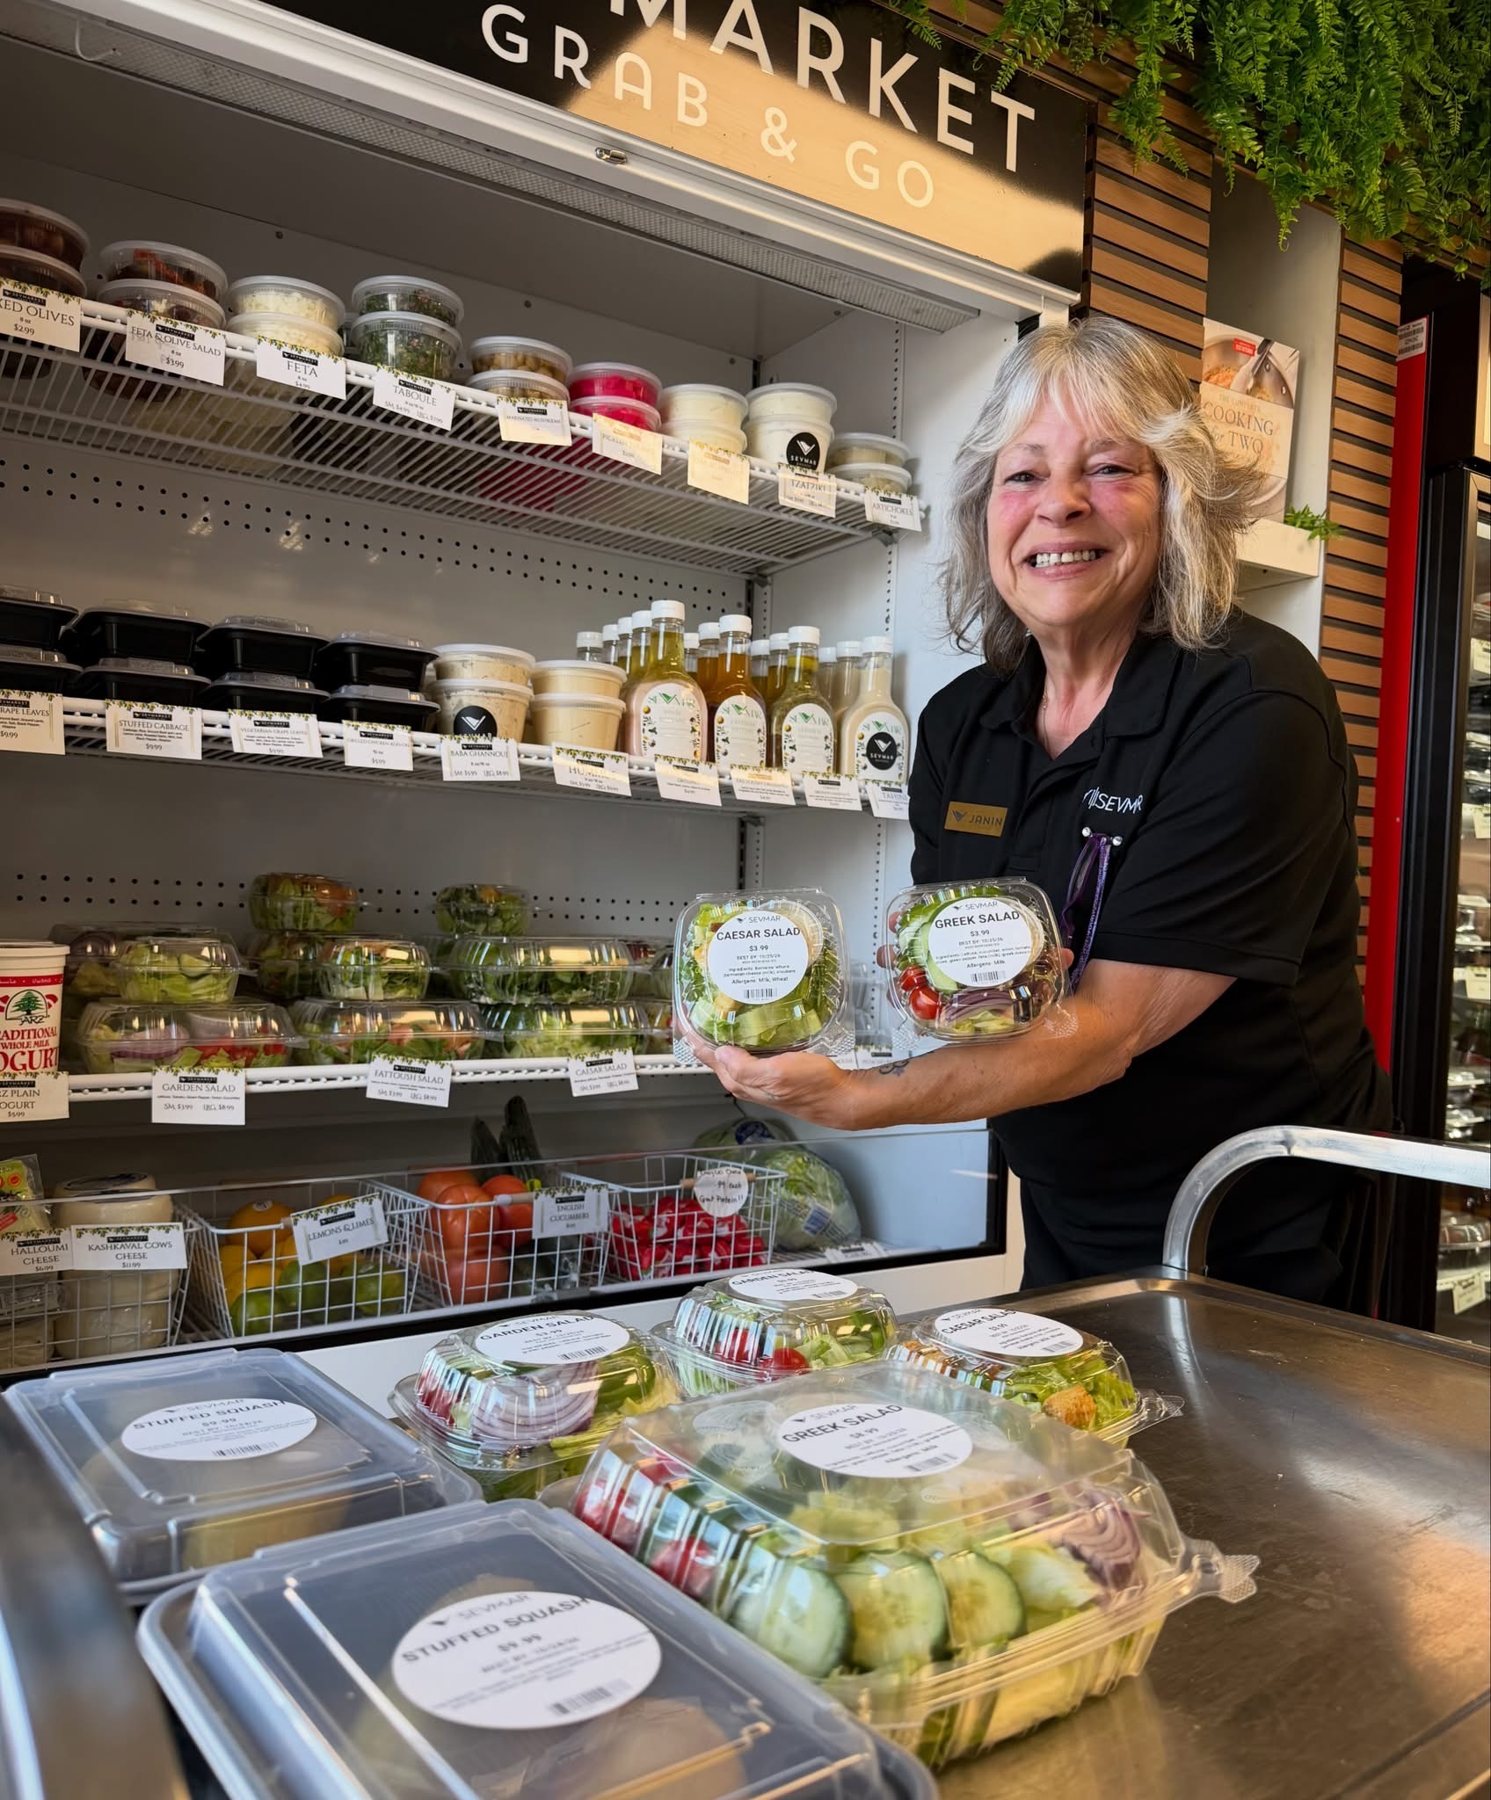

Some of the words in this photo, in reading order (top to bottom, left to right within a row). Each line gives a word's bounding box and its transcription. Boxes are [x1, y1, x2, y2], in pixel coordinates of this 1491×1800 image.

[481, 4, 709, 127] GRAB
[760, 106, 797, 161] &
[845, 140, 934, 208] GO
[26, 305, 75, 327] OLIVES
[131, 326, 153, 339] FETA
[163, 335, 191, 350] OLIVE
[192, 343, 221, 358] SALAD
[287, 361, 318, 378] FETA
[393, 385, 438, 407] TABOULE
[1203, 401, 1273, 436] COOKING
[1229, 430, 1263, 454] TWO
[0, 707, 21, 716] RAPE
[22, 709, 50, 717] LEAVES
[119, 720, 152, 729] STUFFED
[154, 723, 189, 731] CABBAGE
[965, 901, 998, 911] SEVMAR
[749, 915, 781, 924] SEVMAR
[935, 915, 976, 929] GREEK
[978, 910, 1020, 924] SALAD
[716, 930, 761, 941] CAESAR
[763, 927, 801, 938] SALAD
[749, 944, 769, 952] $3.99
[0, 1026, 57, 1041] ADITIONAL
[1, 1041, 33, 1050] WHOLE
[0, 1047, 59, 1073] OGURT
[604, 1063, 628, 1073] SALAD
[374, 1070, 416, 1081] FATTOUSH
[417, 1074, 444, 1085] SALAD
[162, 1083, 203, 1093] GARDEN
[205, 1084, 236, 1093] SALAD
[0, 1101, 35, 1109] OGURT
[557, 1203, 585, 1213] ENGLISH
[308, 1225, 343, 1241] LEMONS
[352, 1217, 375, 1231] LIMES
[11, 1243, 69, 1255] HALLOUMI
[88, 1242, 144, 1252] KASHKAVAL
[144, 1241, 173, 1250] COWS
[23, 1255, 60, 1265] CHEESE
[115, 1252, 148, 1261] CHEESE
[480, 1324, 543, 1341] GARDEN
[546, 1316, 595, 1329] SALAD
[941, 1318, 981, 1334] CAESAR
[981, 1309, 1017, 1323] SALAD
[133, 1412, 211, 1430] STUFFED
[216, 1400, 286, 1416] SQUASH
[782, 1421, 847, 1443] GREEK
[844, 1403, 903, 1427] SALAD
[458, 1594, 531, 1620] SEVMAR
[402, 1623, 501, 1662] STUFFED
[503, 1596, 590, 1628] SQUASH
